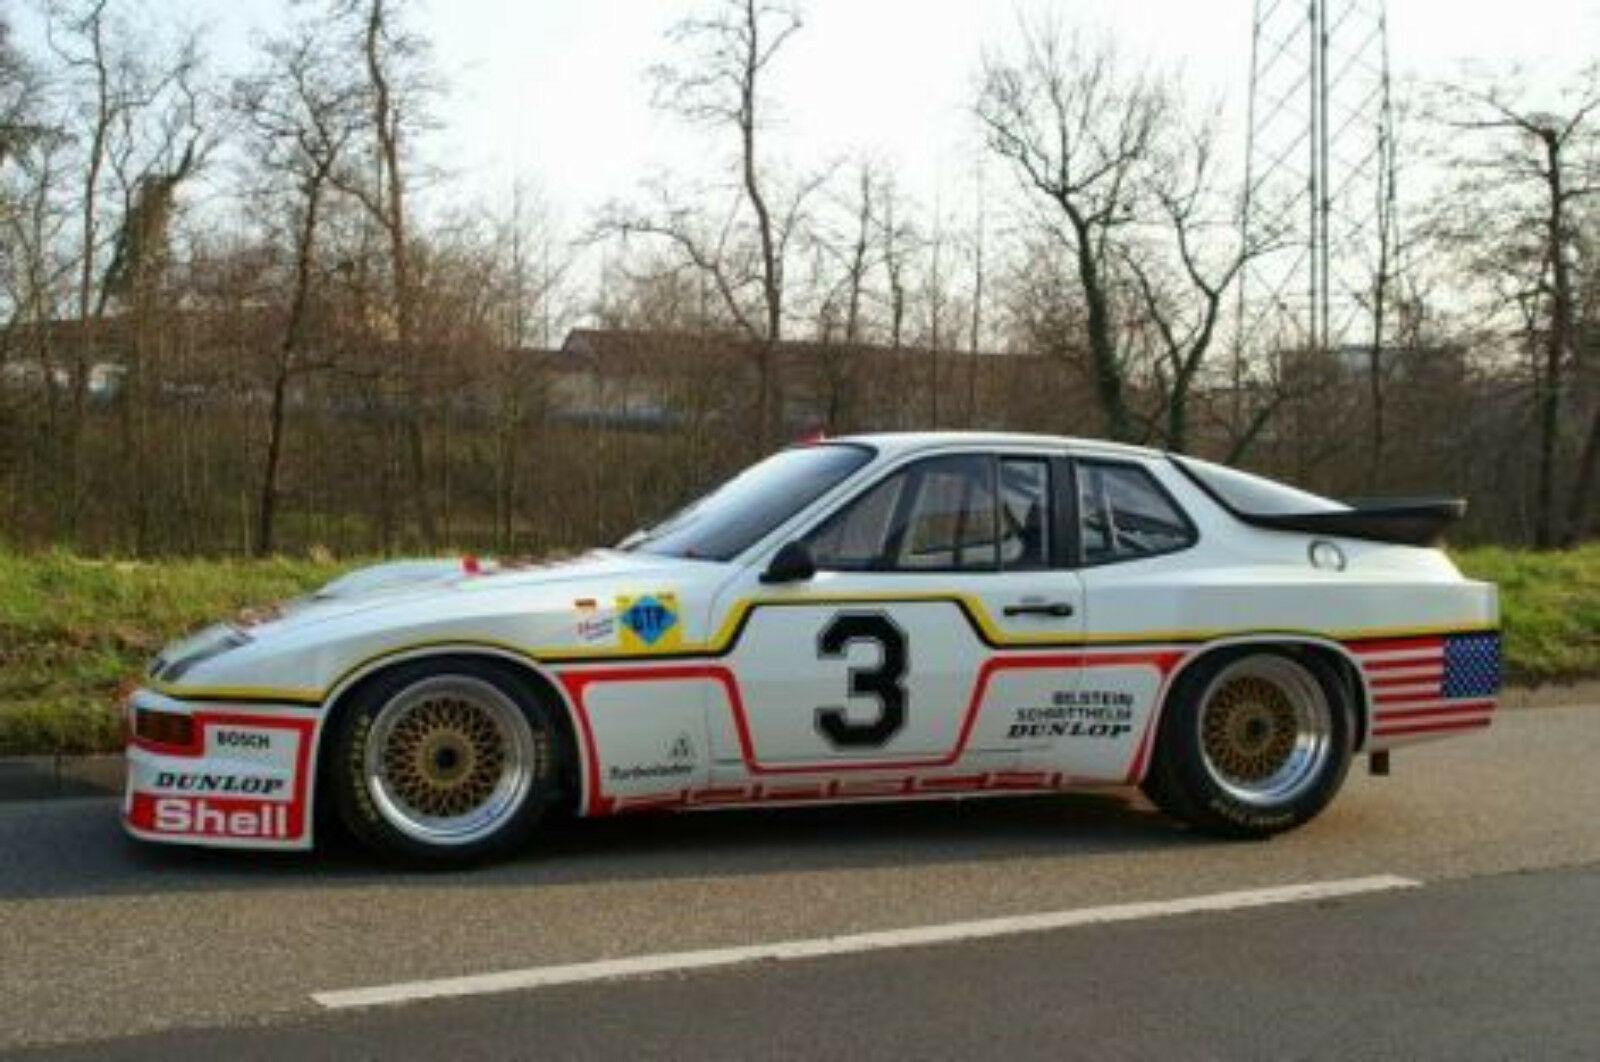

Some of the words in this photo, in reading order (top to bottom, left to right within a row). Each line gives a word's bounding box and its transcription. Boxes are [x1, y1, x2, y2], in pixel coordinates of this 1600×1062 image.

[815, 612, 909, 751] 3
[217, 730, 270, 749] BOSCH
[1007, 722, 1131, 739] DUNLOP
[155, 772, 285, 794] DUNLOP
[155, 799, 287, 837] Shell
